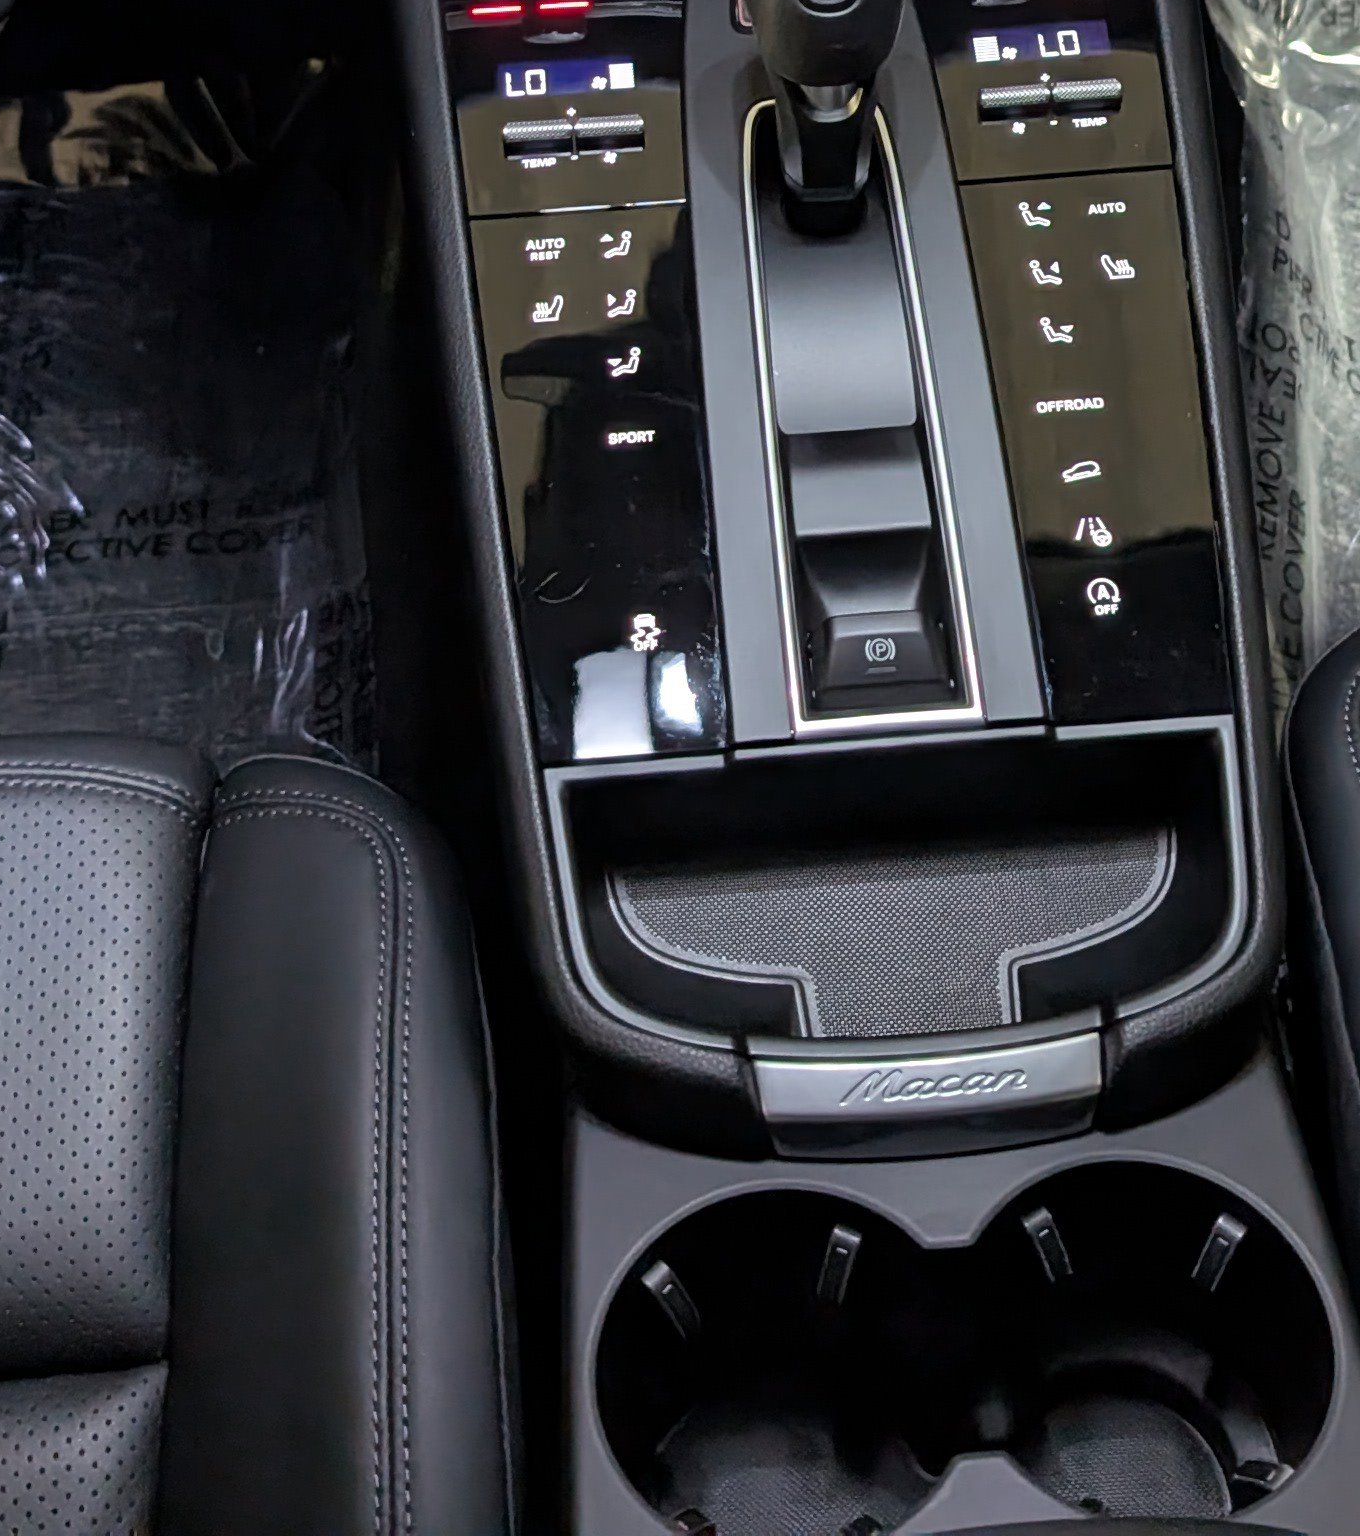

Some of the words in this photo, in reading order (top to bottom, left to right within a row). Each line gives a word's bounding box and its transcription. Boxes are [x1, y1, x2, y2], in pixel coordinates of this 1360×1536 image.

[1037, 29, 1081, 58] LO
[505, 68, 546, 97] LO
[1071, 116, 1108, 129] TEMP
[522, 157, 557, 169] TEMP
[1088, 201, 1126, 215] AUTO
[525, 237, 566, 252] AUTO
[530, 250, 561, 262] REST
[1036, 397, 1104, 414] OFFROAD
[608, 430, 656, 445] SPORT
[118, 500, 210, 529] MUST
[1279, 490, 1306, 630] COVER
[1094, 604, 1119, 616] OFF
[633, 639, 658, 652] OFF
[839, 1068, 1028, 1107] Macan
